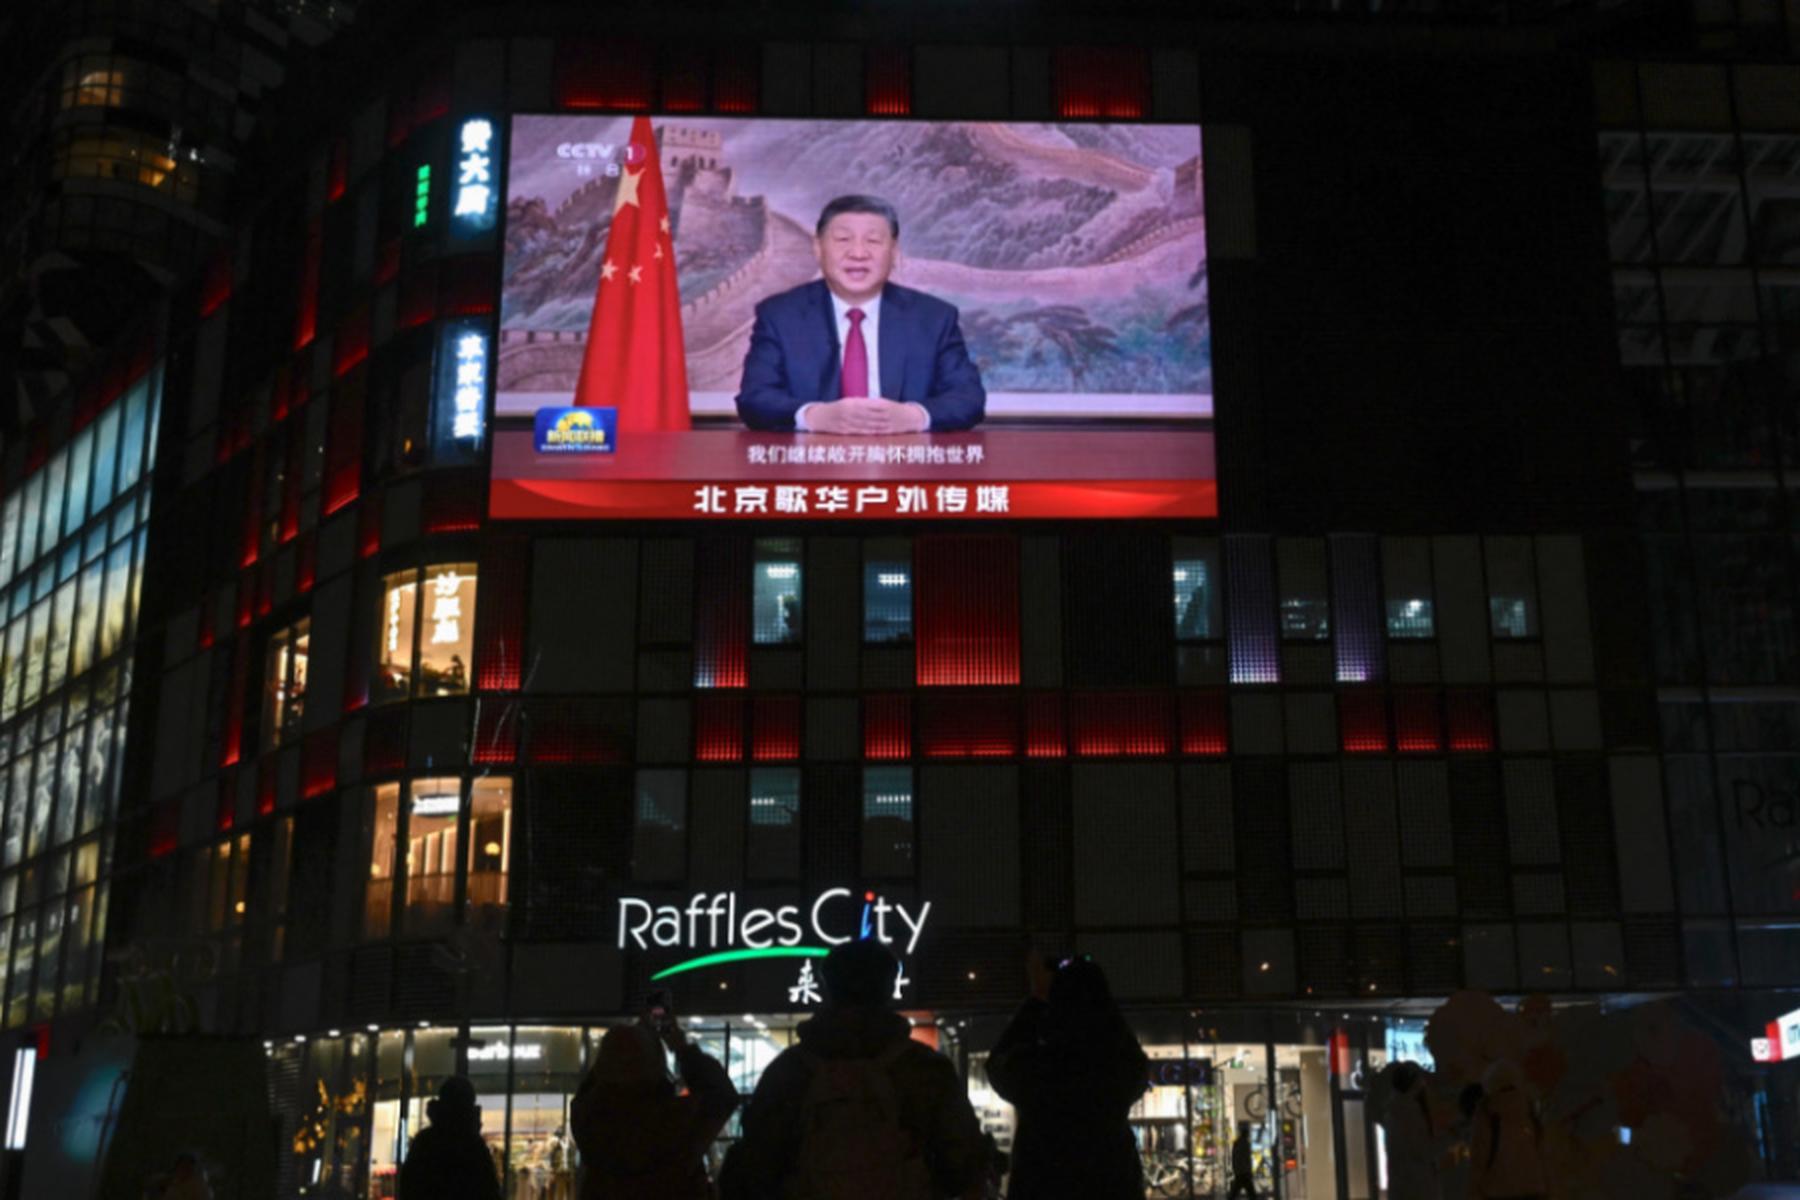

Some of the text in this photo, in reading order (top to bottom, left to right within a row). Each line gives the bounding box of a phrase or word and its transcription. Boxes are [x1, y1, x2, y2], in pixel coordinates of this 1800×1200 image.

[556, 142, 615, 159] CCTV
[694, 486, 1009, 513] 北京歌华户外传媒
[618, 887, 931, 955] Raffles City
